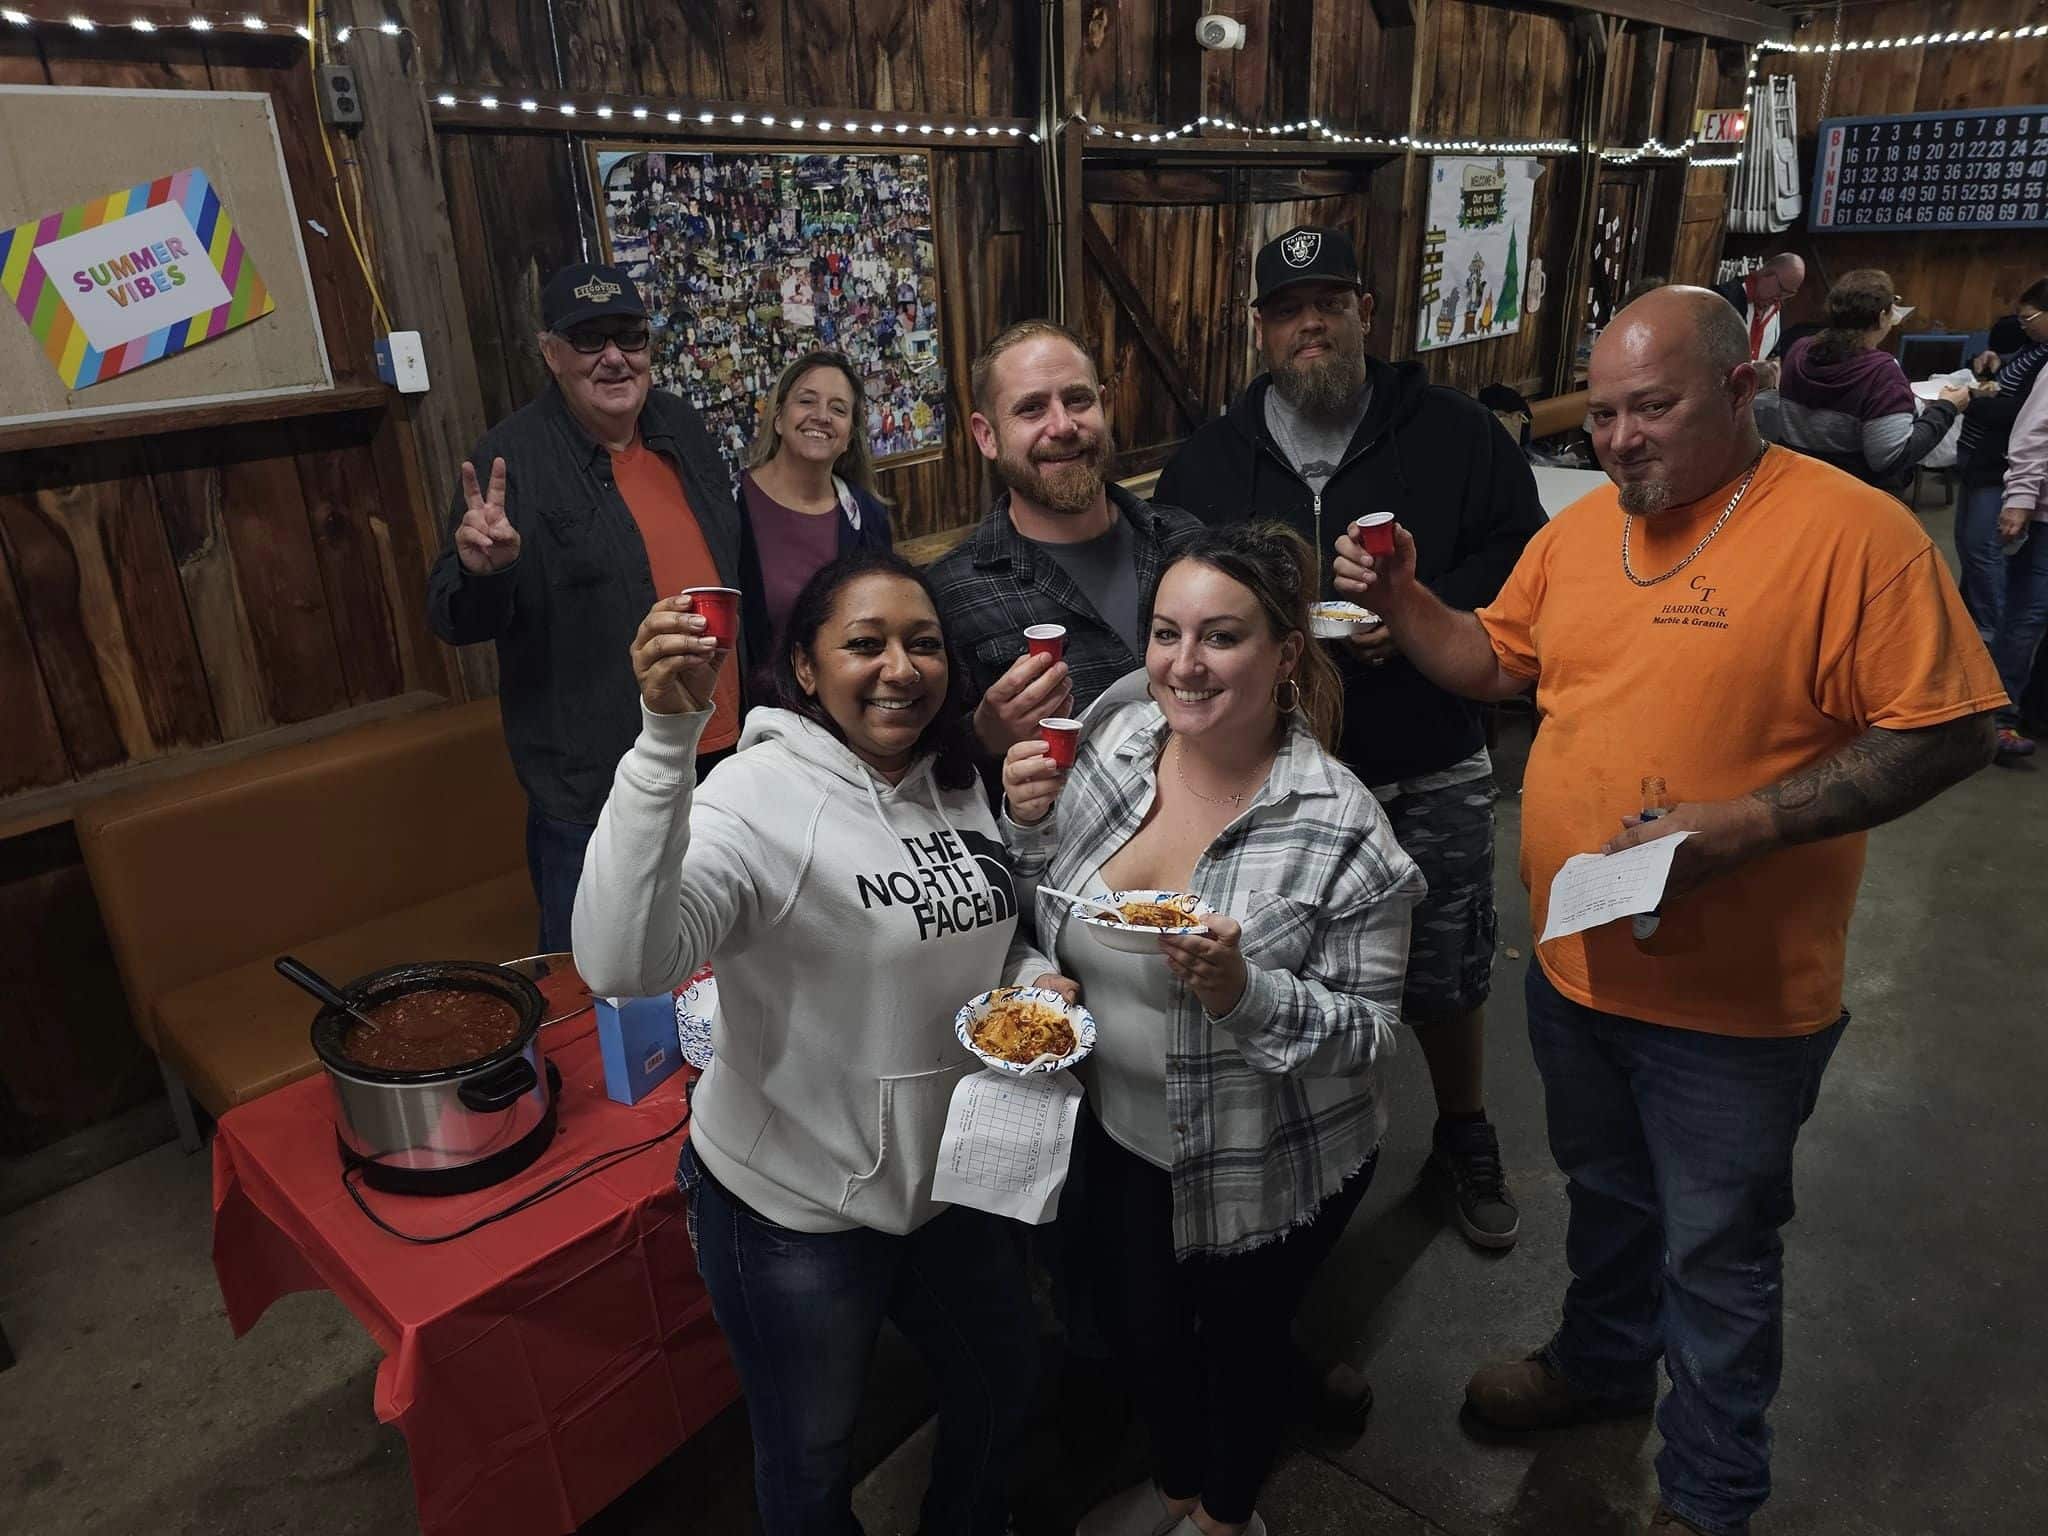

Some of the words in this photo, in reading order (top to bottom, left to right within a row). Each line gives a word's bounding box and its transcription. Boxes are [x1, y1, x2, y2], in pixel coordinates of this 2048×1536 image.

[1853, 128, 1857, 142] 1
[1871, 126, 1879, 142] 2
[1892, 125, 1900, 141] 3
[1913, 124, 1921, 139] 4
[1934, 122, 1943, 138] 5
[1955, 121, 1964, 136] 6
[1977, 119, 1986, 136] 7
[1996, 119, 2006, 135] 8
[2019, 117, 2029, 135] 9
[1846, 149, 1858, 163] 16
[1866, 148, 1879, 162] 17
[1887, 147, 1899, 161] 18
[1908, 145, 1920, 160] 19
[1927, 144, 1943, 160] 20
[1949, 143, 1964, 158] 21
[1968, 142, 1984, 157] 22
[1988, 142, 2005, 157] 23
[2011, 140, 2027, 156] 24
[2032, 139, 2048, 155] 25
[1843, 169, 1856, 184] 31
[1862, 168, 1876, 183] 32
[1882, 167, 1897, 182] 33
[1902, 166, 1918, 181] 34
[1923, 165, 1940, 181] 35
[1944, 164, 1961, 179] 36
[1966, 163, 1981, 179] 37
[1984, 162, 2000, 179] 38
[2006, 161, 2022, 178] 39
[2028, 160, 2045, 177] 40
[1839, 189, 1854, 204] 46
[1860, 188, 1874, 203] 47
[1879, 188, 1894, 203] 48
[1899, 187, 1915, 202] 49
[1920, 186, 1936, 201] 50
[1942, 185, 1957, 200] 51
[1961, 185, 1977, 200] 52
[1980, 184, 1997, 200] 53
[2002, 183, 2019, 199] 54
[2024, 182, 2041, 198] 55
[1837, 209, 1850, 223] 61
[1856, 208, 1871, 223] 62
[1876, 208, 1891, 223] 63
[1896, 207, 1912, 222] 64
[1917, 206, 1932, 222] 65
[1937, 206, 1953, 221] 66
[1958, 205, 1974, 221] 67
[1977, 205, 1993, 221] 68
[1999, 204, 2016, 220] 69
[2022, 203, 2038, 219] 70
[73, 237, 188, 293] SUMMER
[106, 265, 186, 308] VIBES
[1653, 616, 1681, 624] Marble
[1691, 618, 1729, 629] Granite
[1662, 605, 1727, 617] HARDROCK
[900, 830, 964, 866] THE
[856, 862, 974, 909] NORTH
[912, 893, 993, 941] FACE
